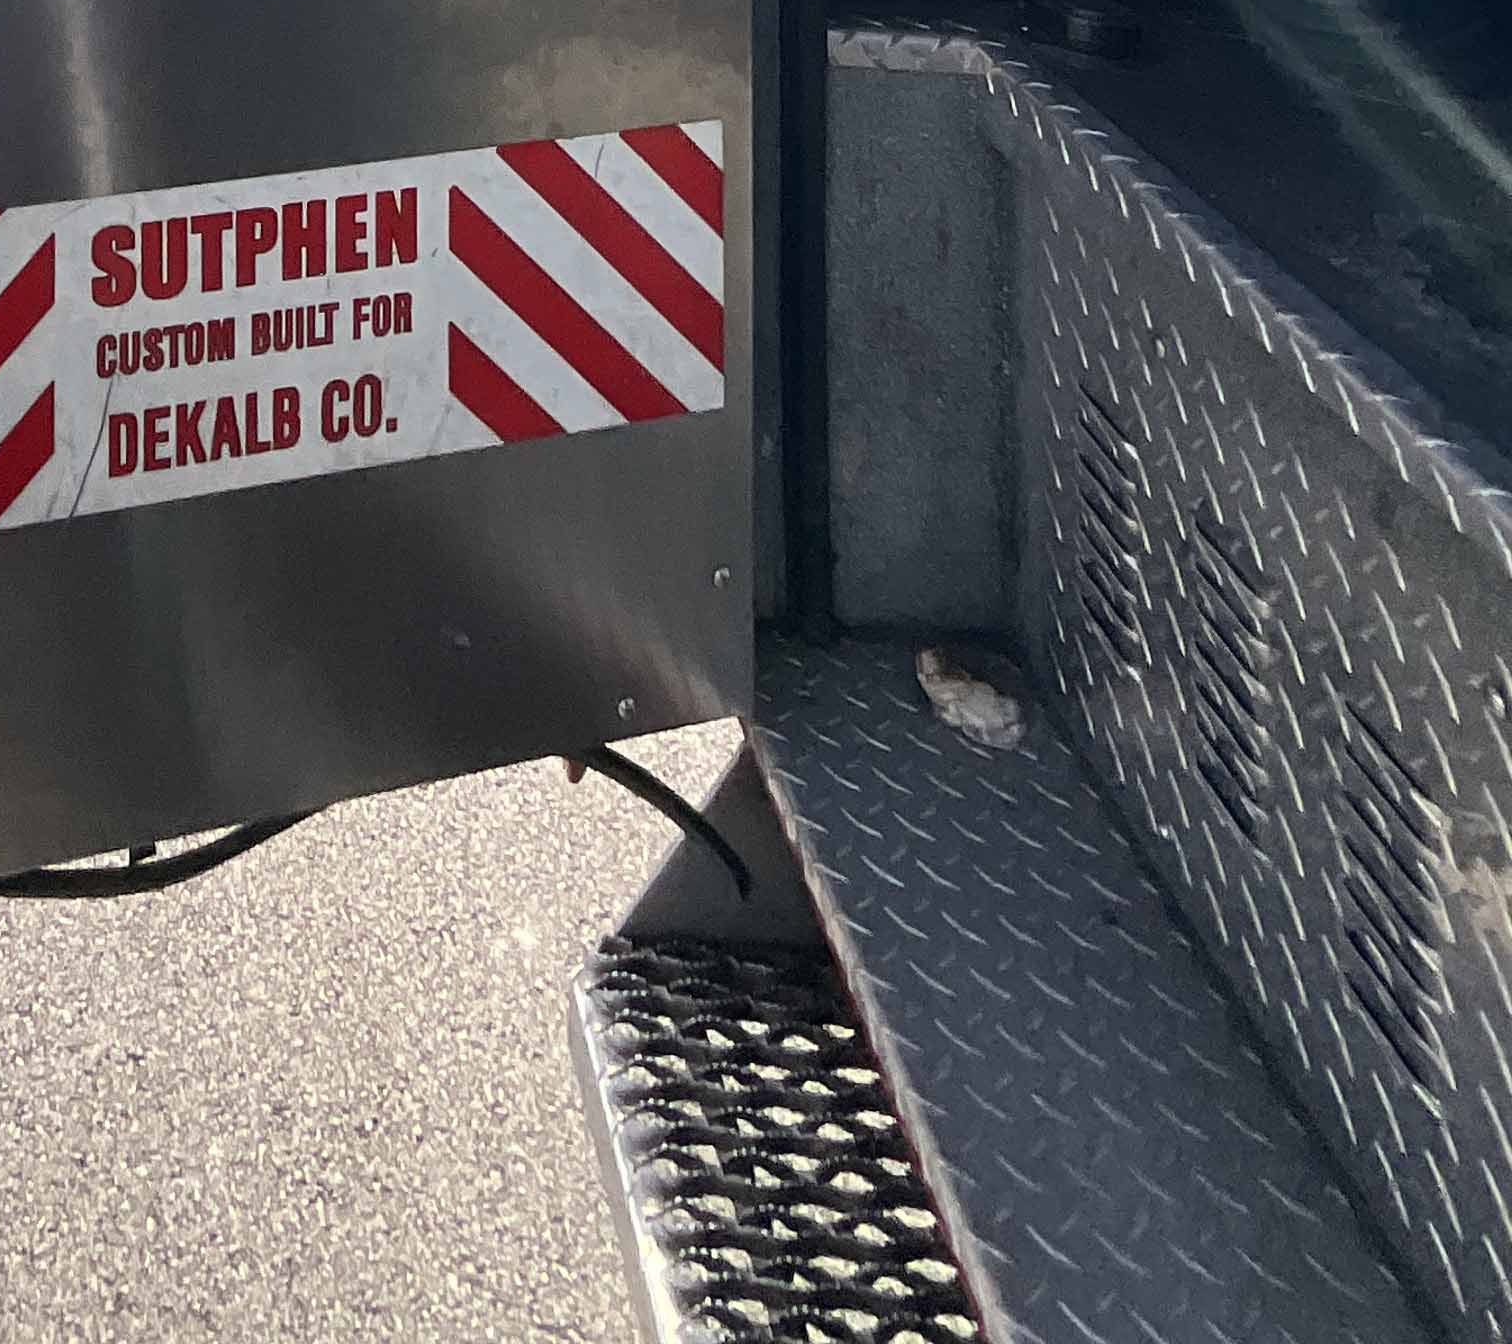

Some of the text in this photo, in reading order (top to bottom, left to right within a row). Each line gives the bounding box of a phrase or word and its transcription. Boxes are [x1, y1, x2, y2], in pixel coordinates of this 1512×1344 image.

[91, 187, 418, 308] SUTPHEN
[96, 292, 412, 378] CUSTOM BUILT FOR
[108, 374, 398, 478] DEKALB CO.
